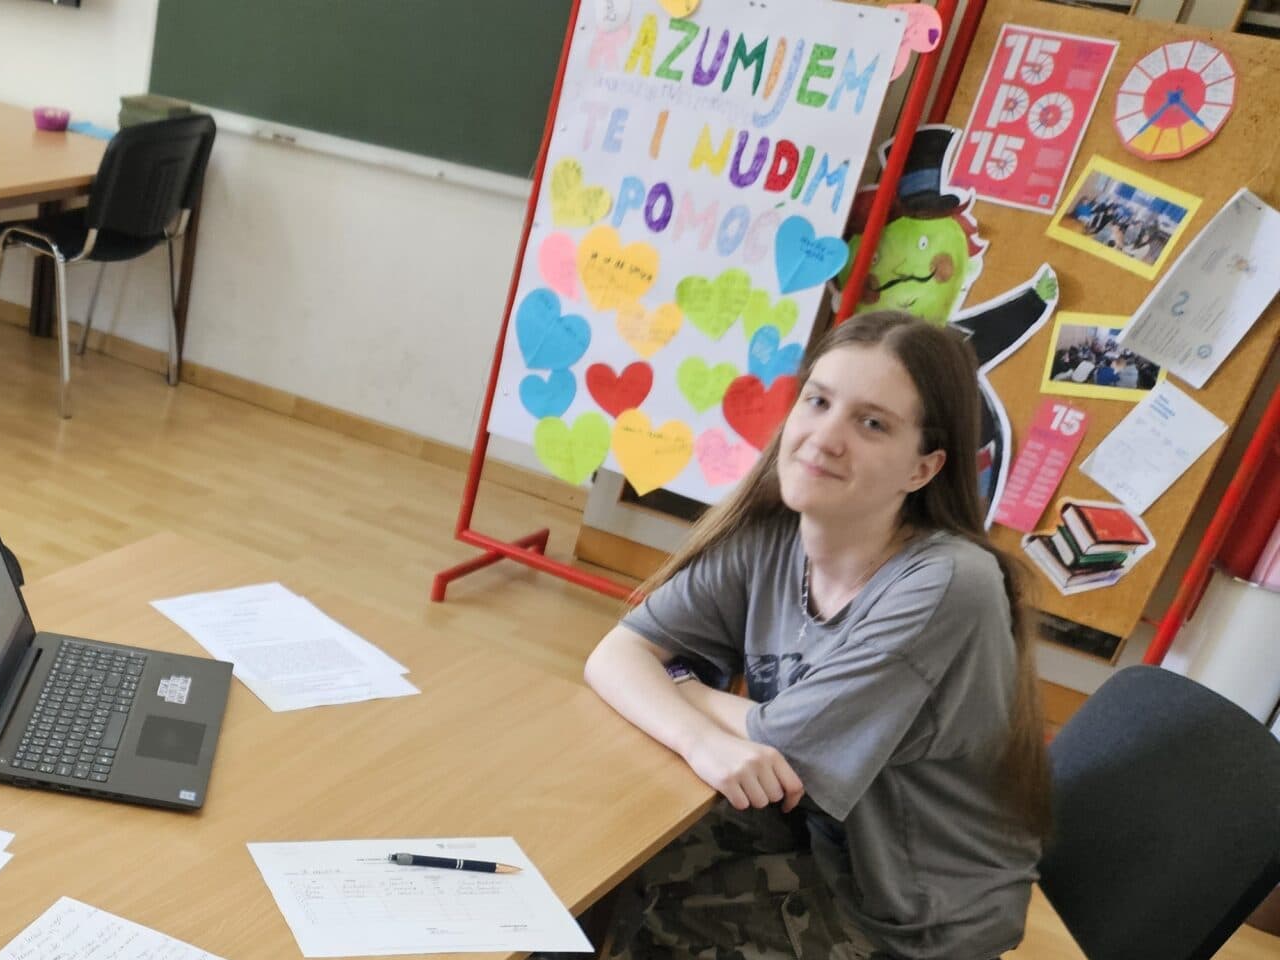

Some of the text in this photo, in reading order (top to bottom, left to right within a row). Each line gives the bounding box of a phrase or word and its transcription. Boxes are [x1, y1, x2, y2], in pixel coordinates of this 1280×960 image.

[588, 13, 879, 127] RAZUMIJEM
[1003, 34, 1061, 85] 15
[581, 101, 850, 214] TE I NUDIM
[969, 130, 1026, 181] 15
[611, 176, 785, 264] POMOĆ
[1050, 404, 1086, 436] 15
